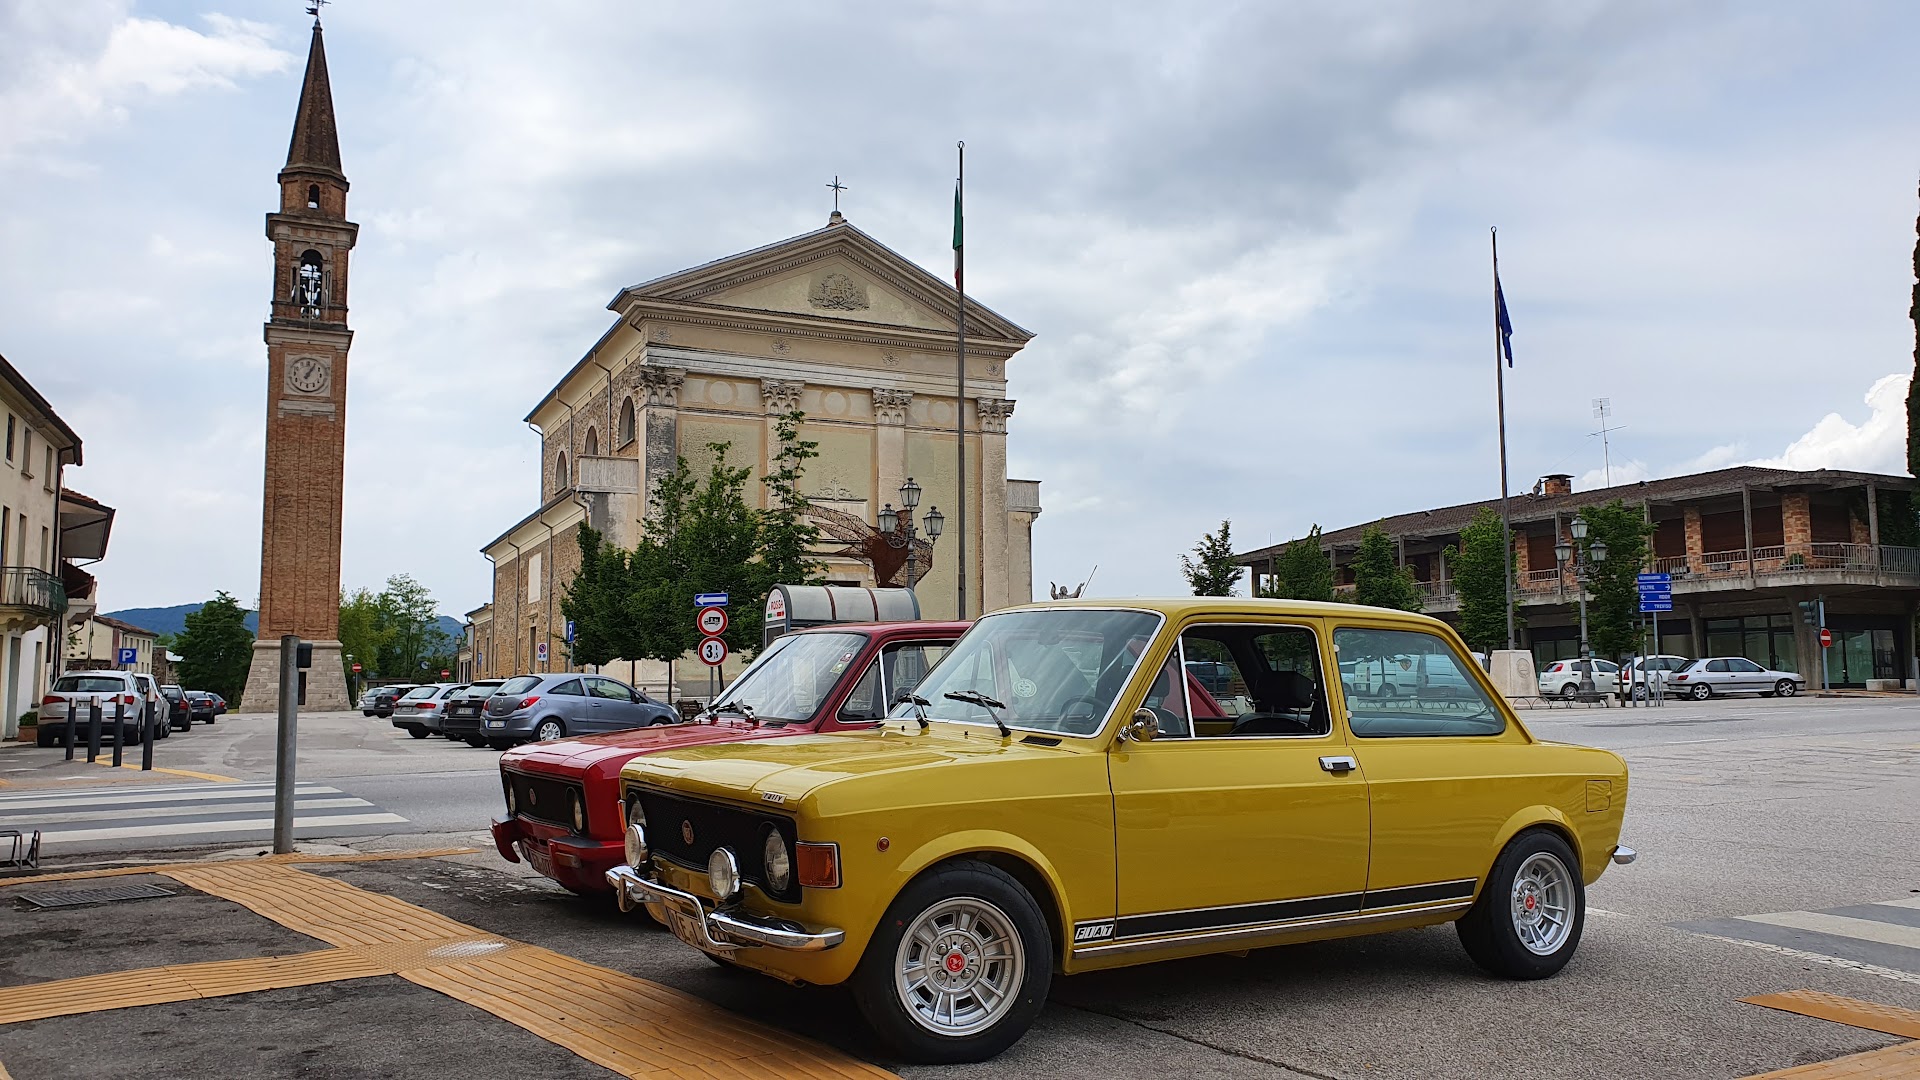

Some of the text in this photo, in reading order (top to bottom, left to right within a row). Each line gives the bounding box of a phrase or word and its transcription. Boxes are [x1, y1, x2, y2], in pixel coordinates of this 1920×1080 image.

[771, 600, 783, 610] ROSSA
[121, 649, 133, 662] P
[1076, 924, 1114, 940] FIAT
